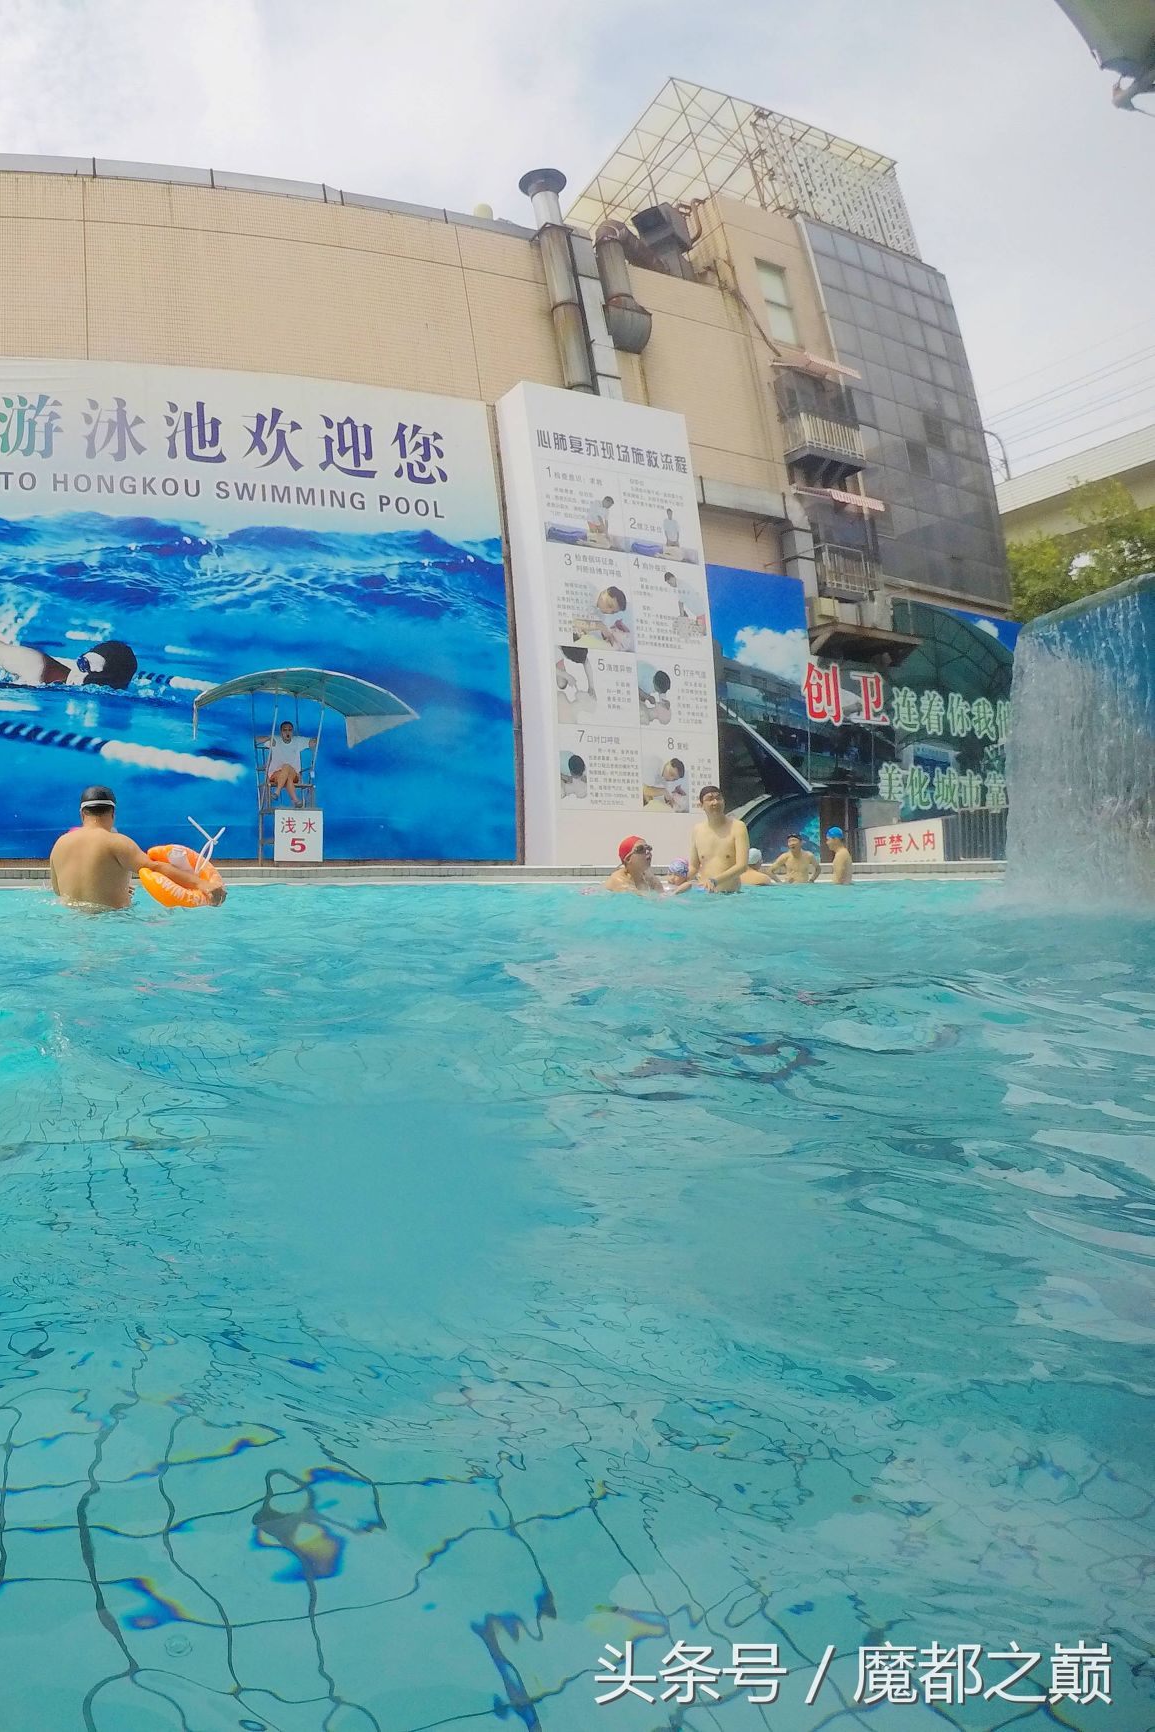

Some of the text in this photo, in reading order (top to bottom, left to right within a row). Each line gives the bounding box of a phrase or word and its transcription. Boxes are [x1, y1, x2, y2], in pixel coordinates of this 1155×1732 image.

[536, 429, 688, 474] 心肺复苏现场施救流程
[0, 471, 37, 491] TO
[52, 473, 201, 498] HONGKOU
[215, 481, 366, 511] SWIMMING
[379, 494, 446, 519] POOL
[564, 553, 572, 566] 3
[633, 557, 640, 569] 4
[597, 659, 605, 671] 5
[674, 664, 681, 676] 6
[803, 661, 889, 726] 创卫
[577, 730, 585, 742] 7
[667, 737, 674, 750] 8
[281, 816, 317, 834] 浅水
[290, 837, 306, 853] 5
[874, 829, 935, 856] 严禁入内
